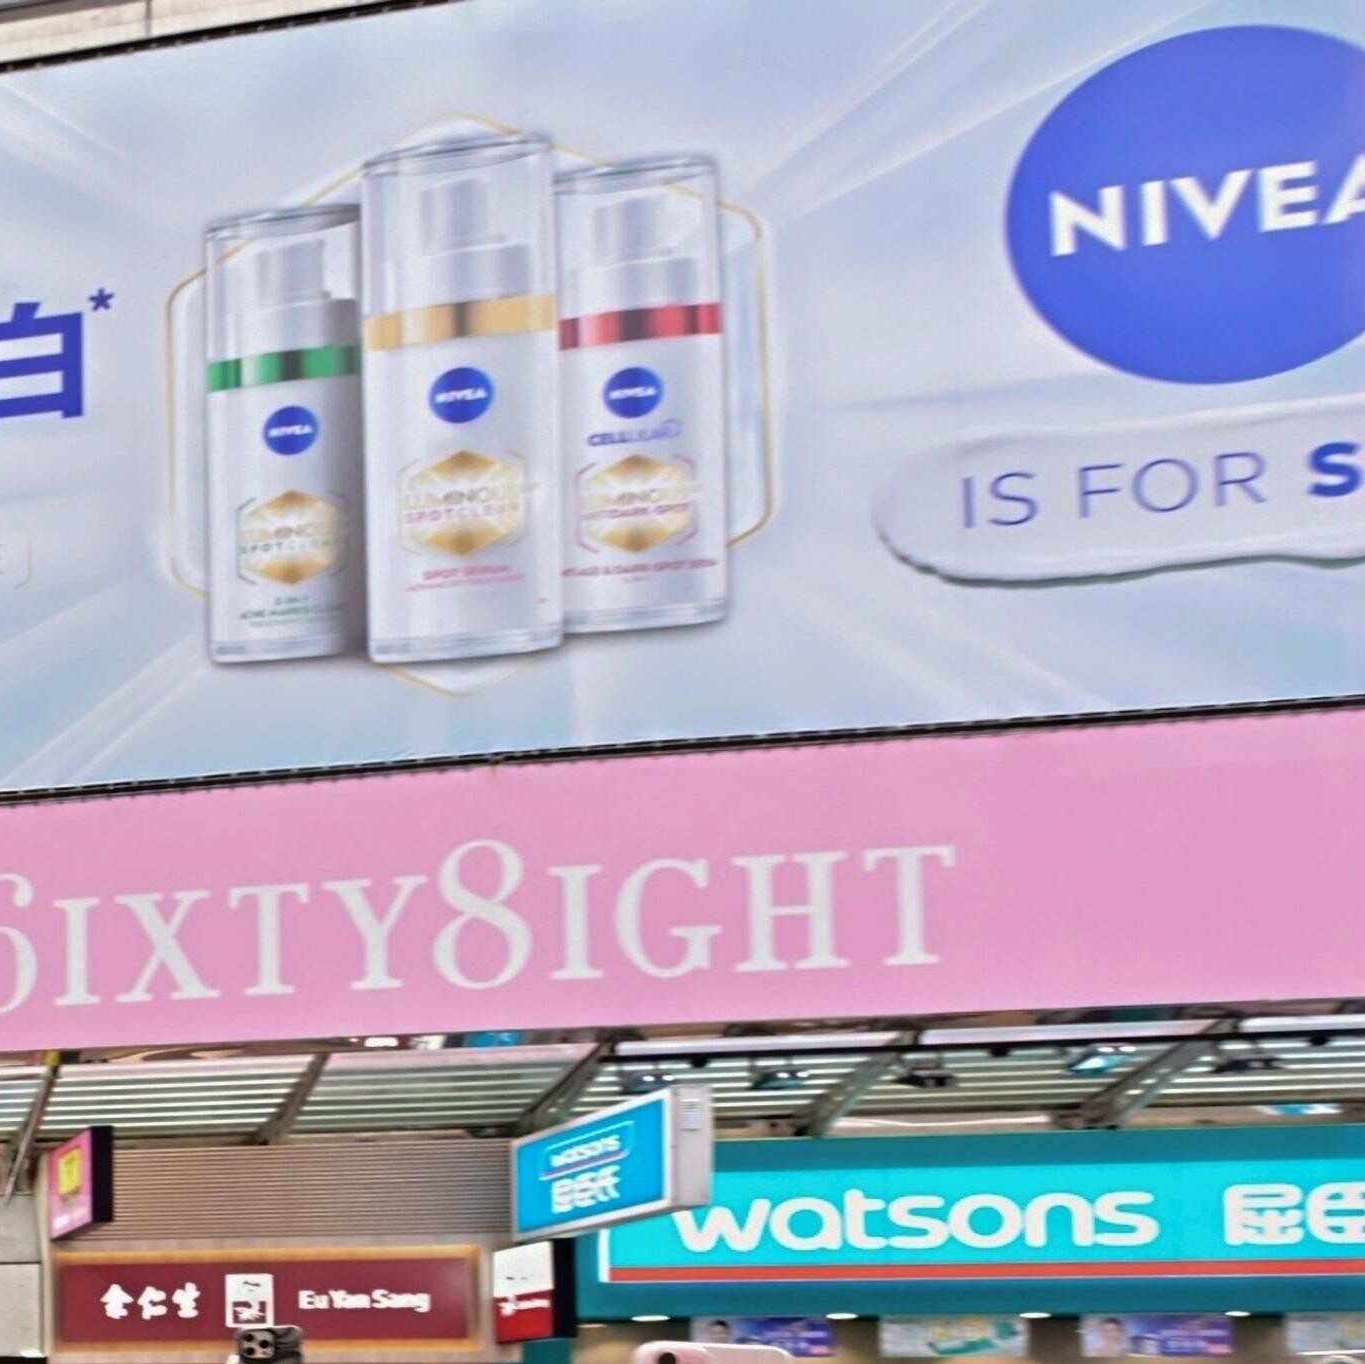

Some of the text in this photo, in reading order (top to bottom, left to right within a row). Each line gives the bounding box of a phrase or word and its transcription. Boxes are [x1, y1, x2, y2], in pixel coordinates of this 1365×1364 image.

[961, 473, 1040, 528] IS
[1077, 451, 1268, 519] FOR
[671, 1188, 1159, 1252] watsons
[298, 1289, 431, 1313] Eu Yan Sang
